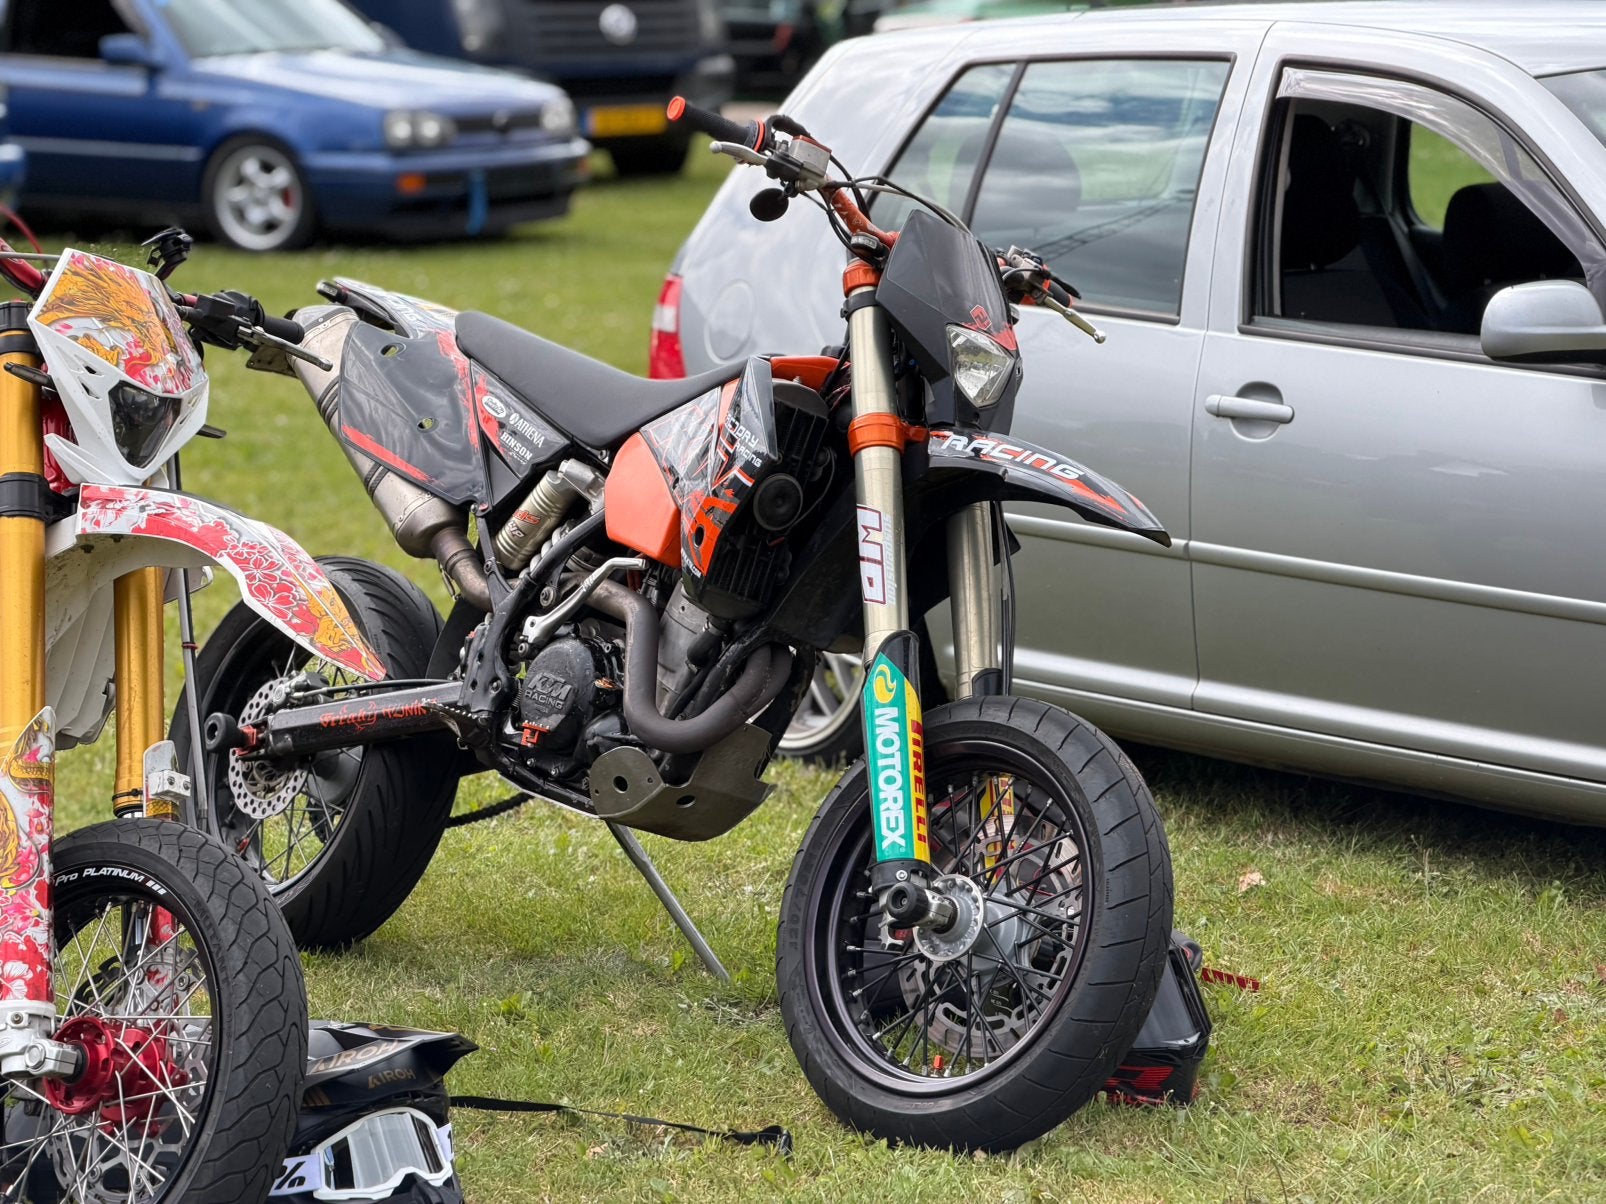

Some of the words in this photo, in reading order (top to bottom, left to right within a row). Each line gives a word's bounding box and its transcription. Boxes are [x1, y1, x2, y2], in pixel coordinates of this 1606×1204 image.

[500, 432, 533, 460] HINSON
[514, 418, 545, 448] ATHENA
[734, 441, 763, 468] RACING
[941, 433, 1085, 480] RACING
[524, 689, 564, 710] RACING
[527, 672, 573, 701] KTM
[874, 706, 906, 850] MOTOREX
[55, 873, 79, 887] Pro
[82, 867, 145, 882] PLATINUM
[193, 899, 231, 986] MUTANT
[313, 1040, 400, 1073] AIROH
[368, 1068, 416, 1089] AIROH
